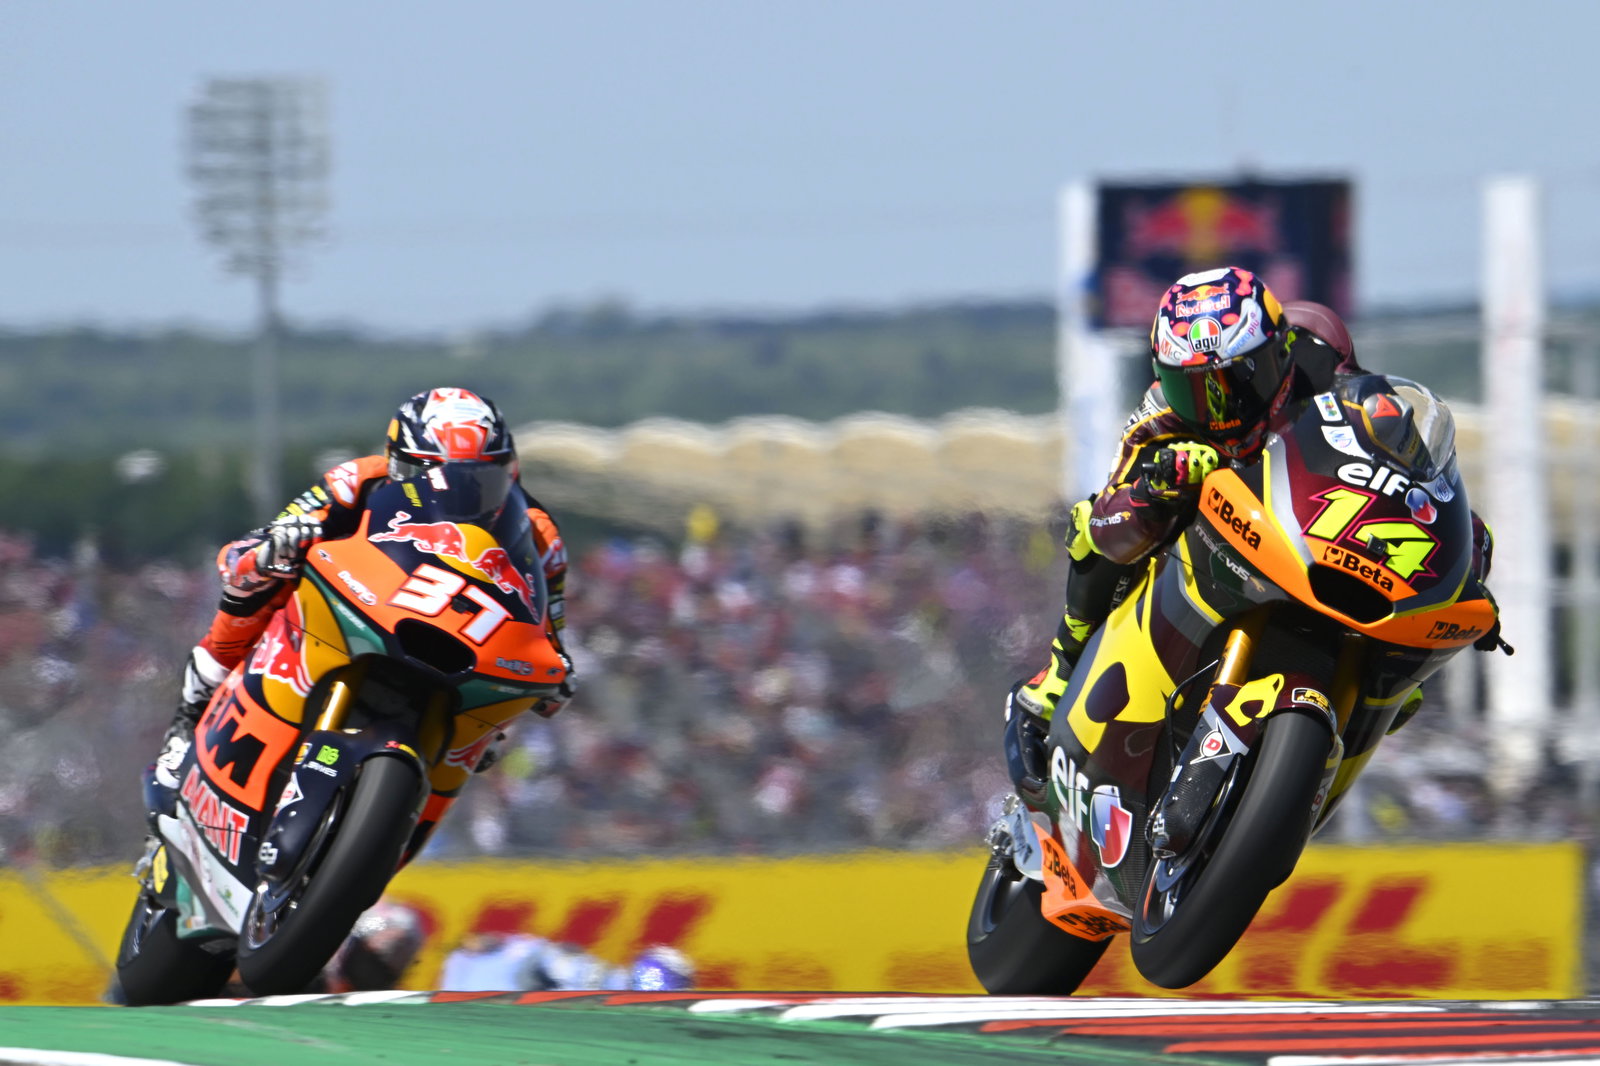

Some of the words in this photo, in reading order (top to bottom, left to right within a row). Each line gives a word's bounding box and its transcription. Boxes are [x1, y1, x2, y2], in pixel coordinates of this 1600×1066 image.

[1194, 336, 1218, 351] agv
[1337, 461, 1410, 497] elf
[1219, 499, 1262, 552] Beta
[1301, 485, 1441, 586] 14
[1341, 549, 1394, 593] Beta
[386, 563, 515, 646] 37
[1441, 623, 1483, 640] Beta
[1051, 745, 1090, 832] elf
[1052, 847, 1078, 900] Beta
